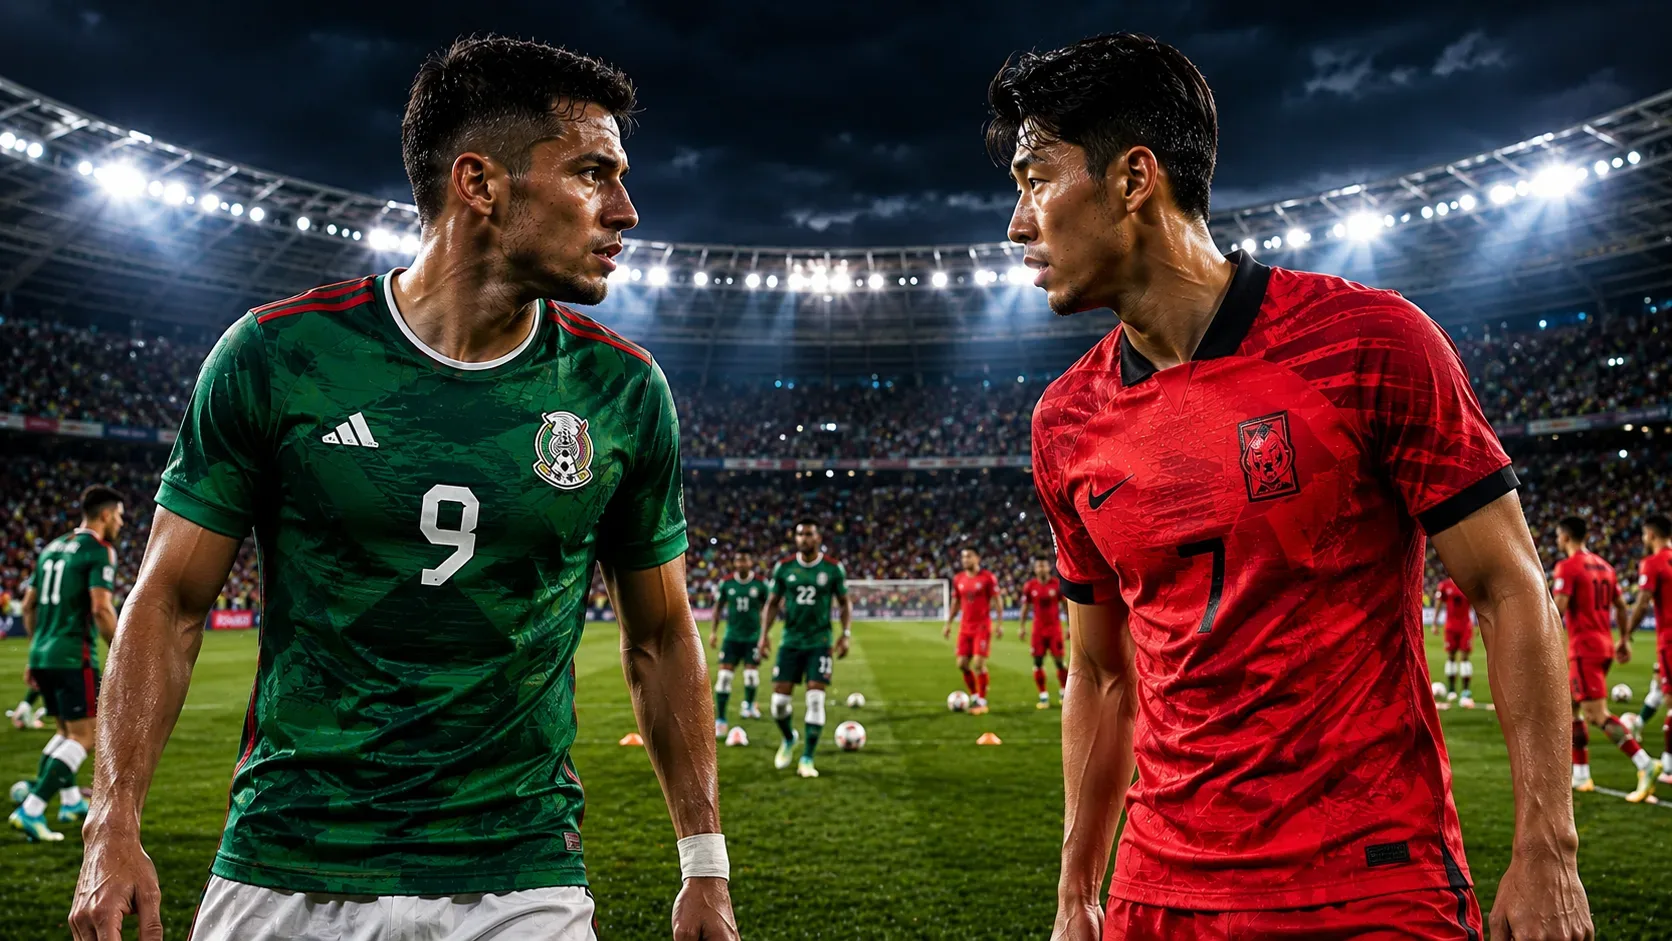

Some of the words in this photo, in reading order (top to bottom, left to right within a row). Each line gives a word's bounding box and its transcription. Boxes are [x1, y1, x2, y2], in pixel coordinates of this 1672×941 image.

[420, 484, 479, 586] 9
[41, 559, 66, 604] 11
[796, 585, 816, 605] 22
[1176, 537, 1225, 633] 7
[1592, 578, 1611, 611] 10
